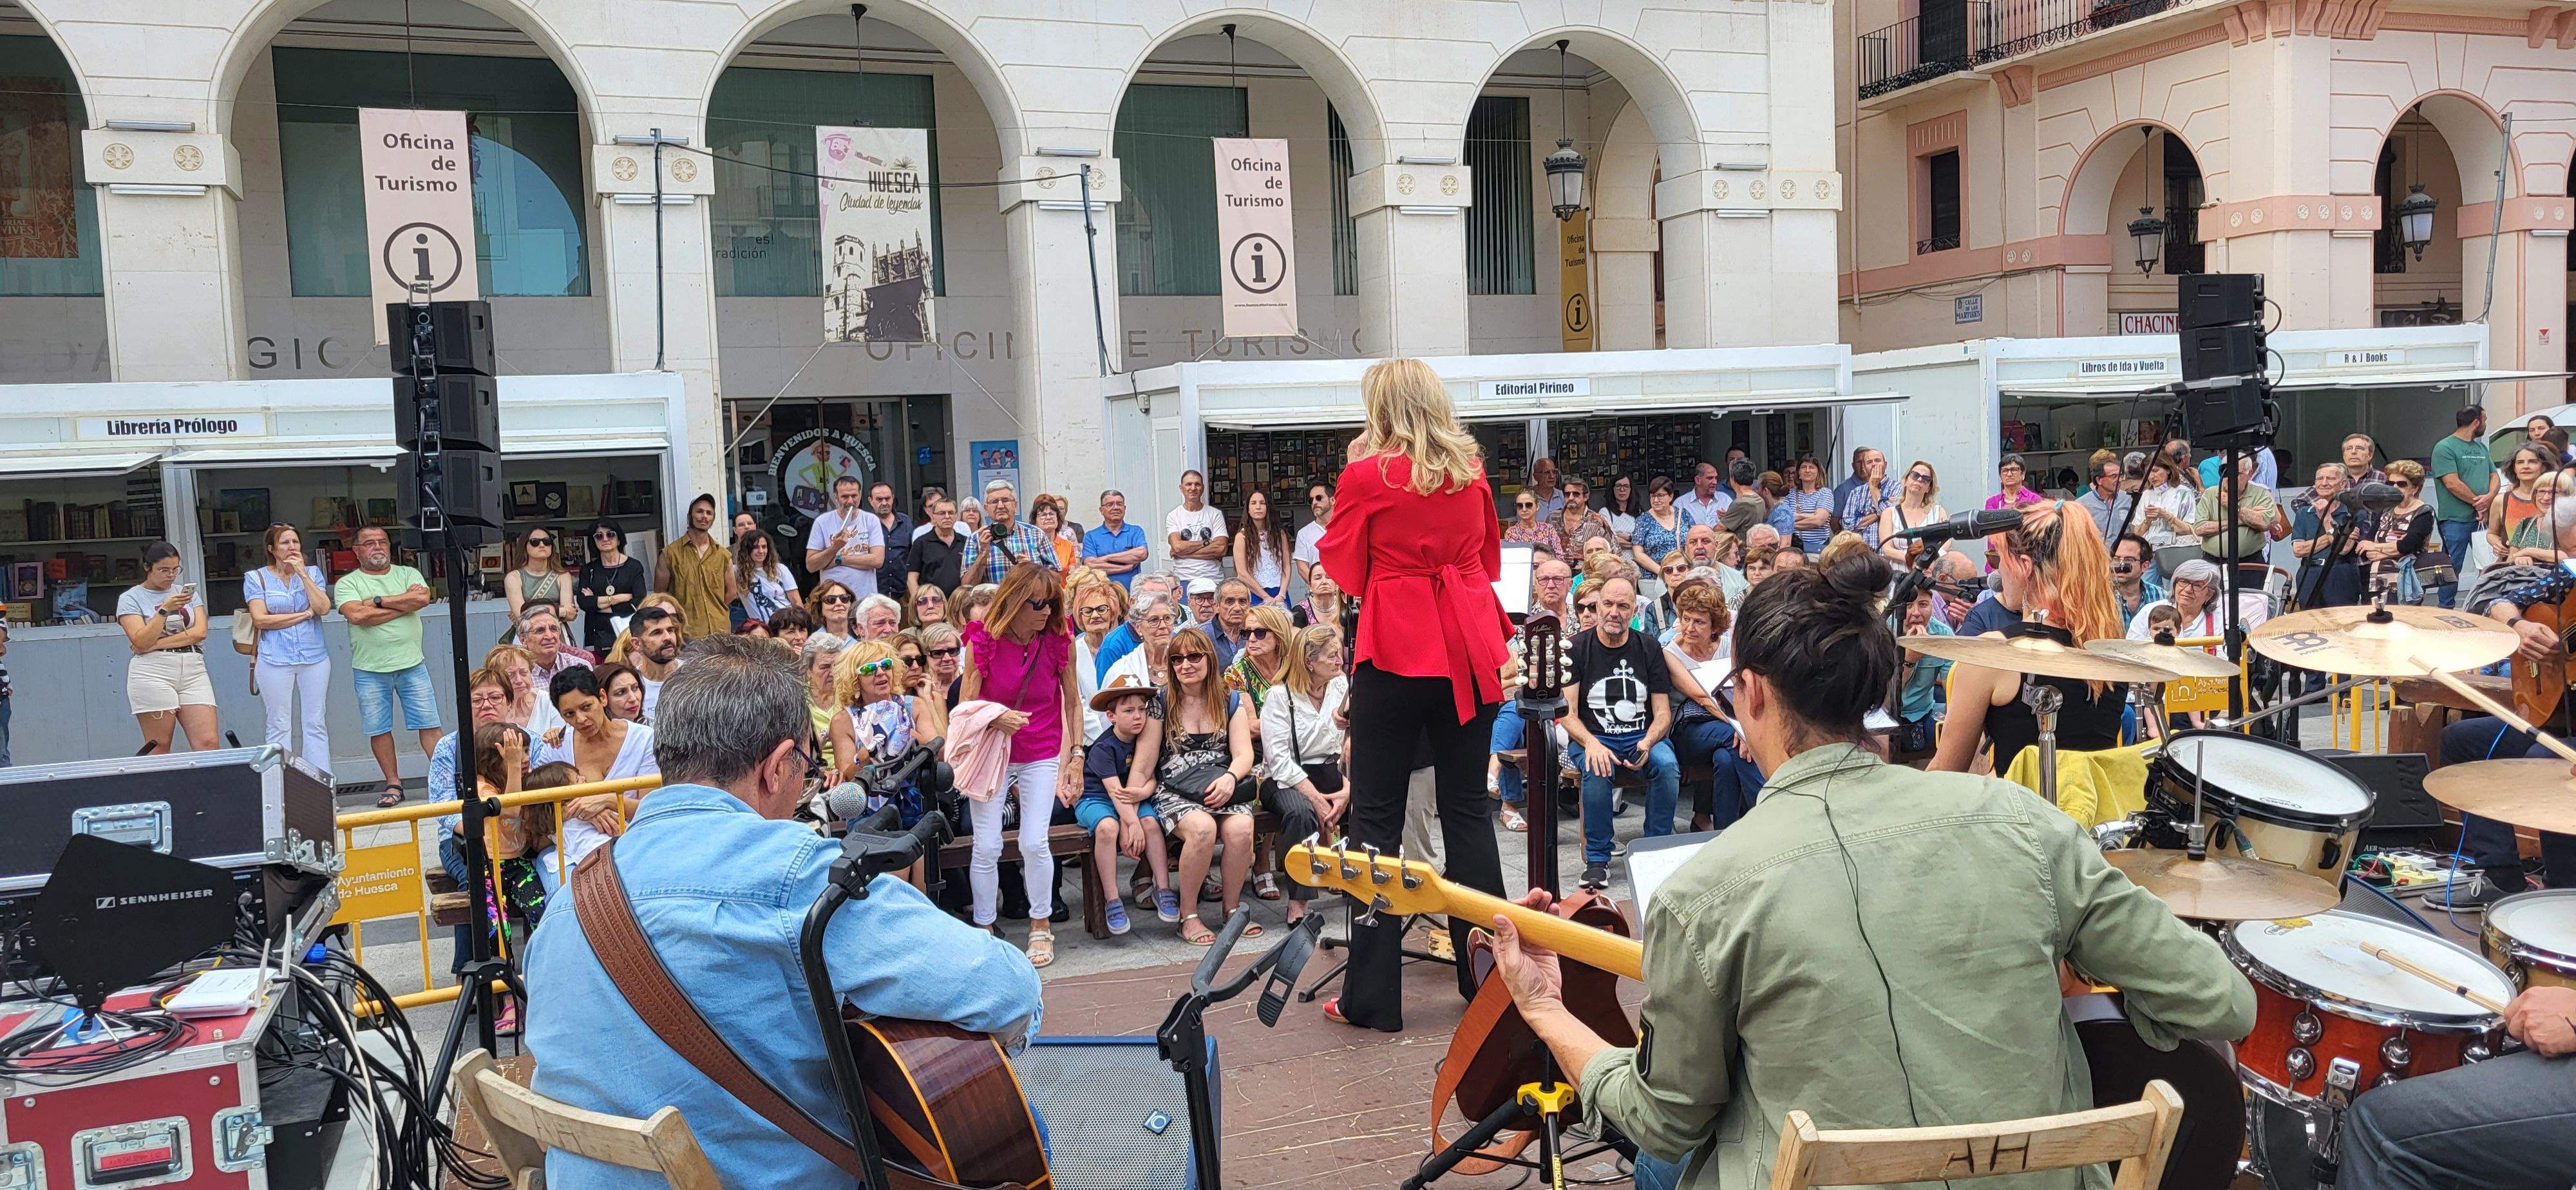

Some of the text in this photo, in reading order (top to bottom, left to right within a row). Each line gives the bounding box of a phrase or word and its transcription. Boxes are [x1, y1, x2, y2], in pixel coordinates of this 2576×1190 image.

[383, 133, 455, 150] Oficina
[431, 155, 456, 171] de
[1231, 158, 1282, 172] Oficina
[375, 175, 458, 192] Turismo
[869, 171, 921, 194] HUESCA
[1265, 176, 1283, 189] de
[839, 192, 923, 215] Ciudad de leyendas
[1225, 194, 1284, 207] Turismo
[1566, 234, 1584, 245] Oficina
[1578, 245, 1585, 254] de
[1565, 257, 1586, 268] Turismo
[2345, 354, 2349, 363] R
[2365, 352, 2388, 363] Books
[2081, 360, 2164, 373] Libros de Ida y Vuelta
[1495, 382, 1575, 395] Editorial Pirineo
[107, 417, 238, 436] Librería Prólogo
[768, 428, 877, 477] BIENVENIDOS A HUESCA
[336, 867, 415, 887] Ayuntamiento
[120, 889, 213, 905] SENNHEISER
[338, 883, 398, 899] de Huesca
